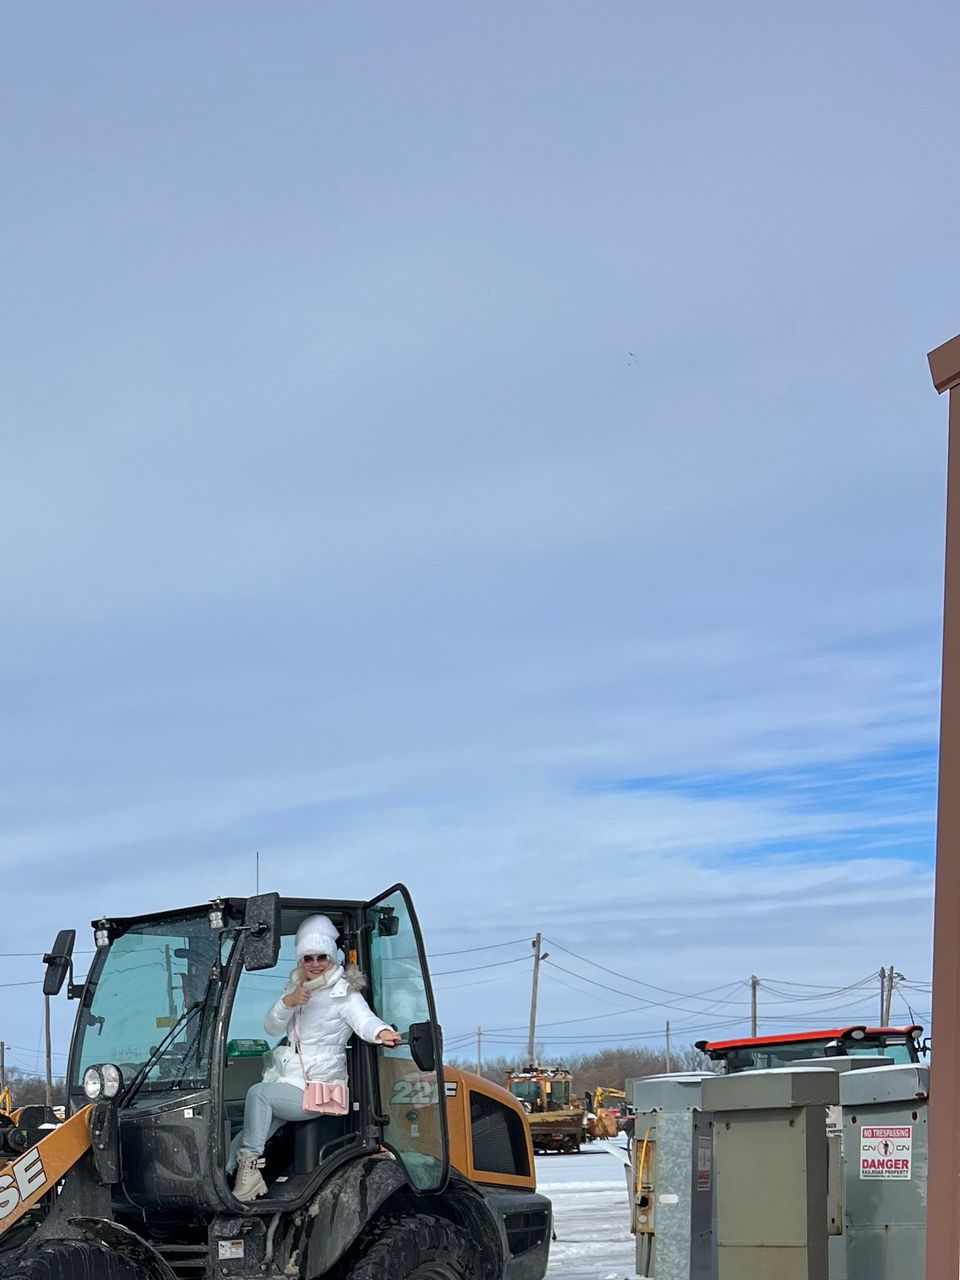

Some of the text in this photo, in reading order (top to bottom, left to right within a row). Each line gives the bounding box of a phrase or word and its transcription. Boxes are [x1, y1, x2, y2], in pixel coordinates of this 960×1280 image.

[863, 1128, 909, 1137] NO TRESPASSING
[861, 1159, 909, 1169] DANGER
